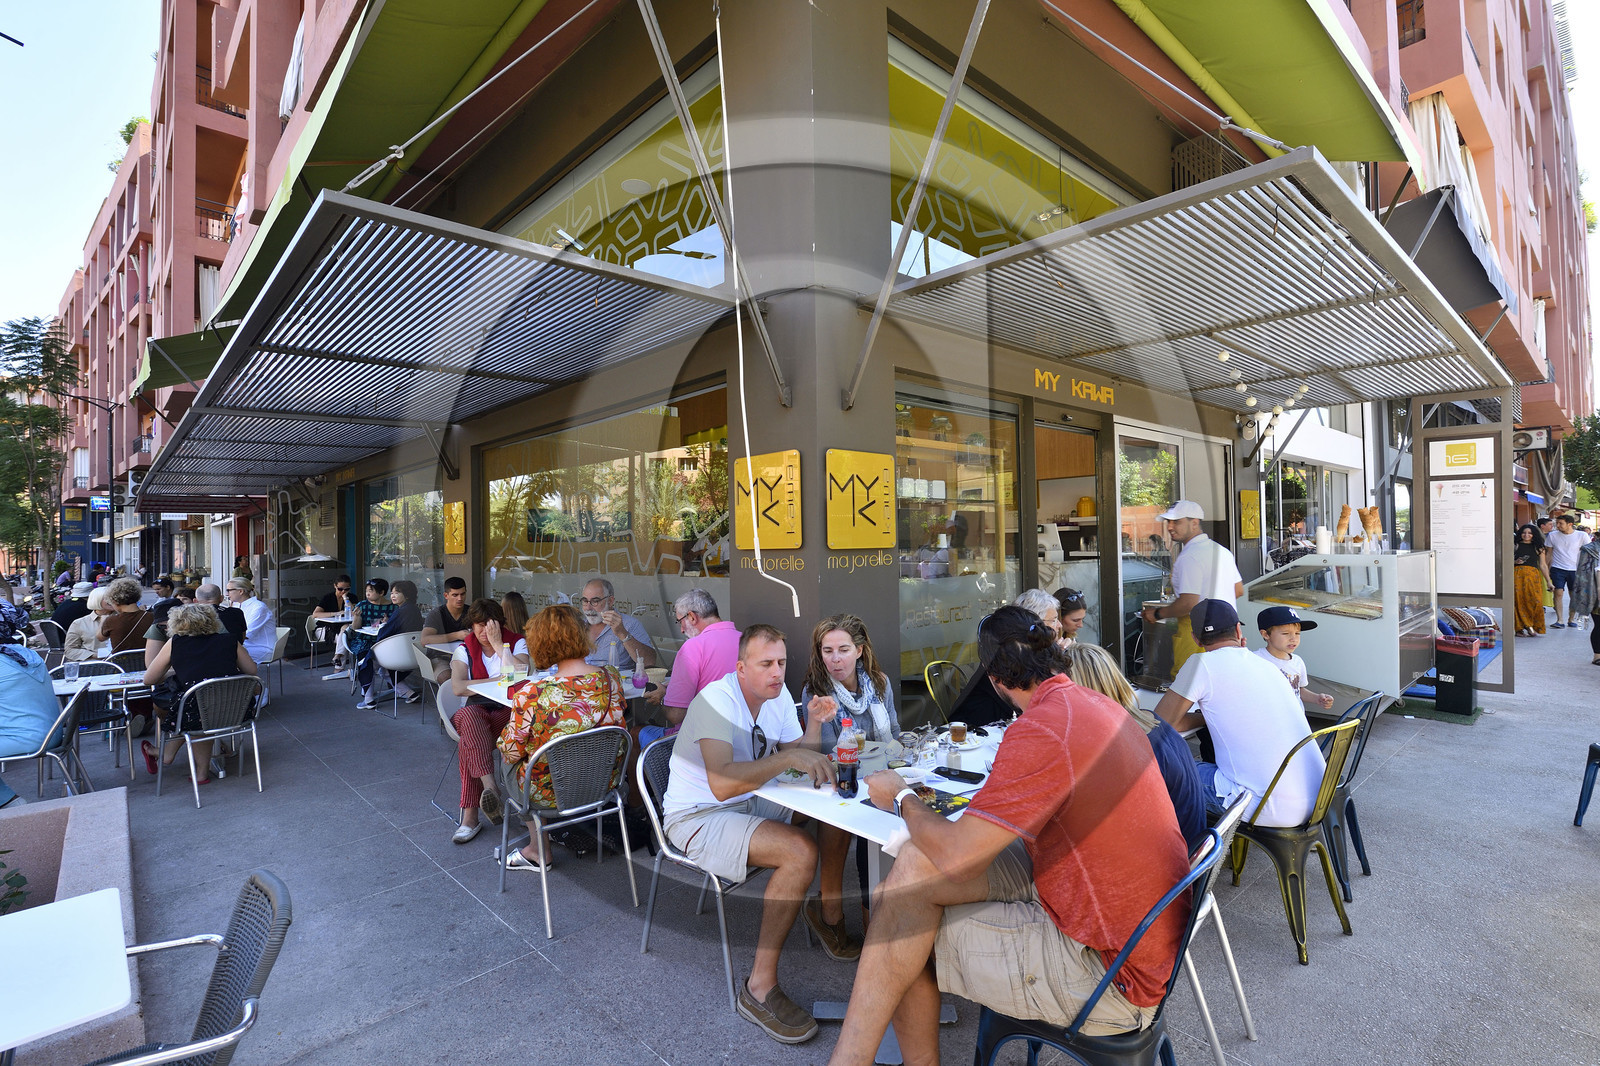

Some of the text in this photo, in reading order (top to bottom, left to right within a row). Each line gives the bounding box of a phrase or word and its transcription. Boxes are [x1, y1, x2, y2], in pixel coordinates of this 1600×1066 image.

[1035, 368, 1115, 406] MY KAWA
[828, 550, 893, 573] majorelle
